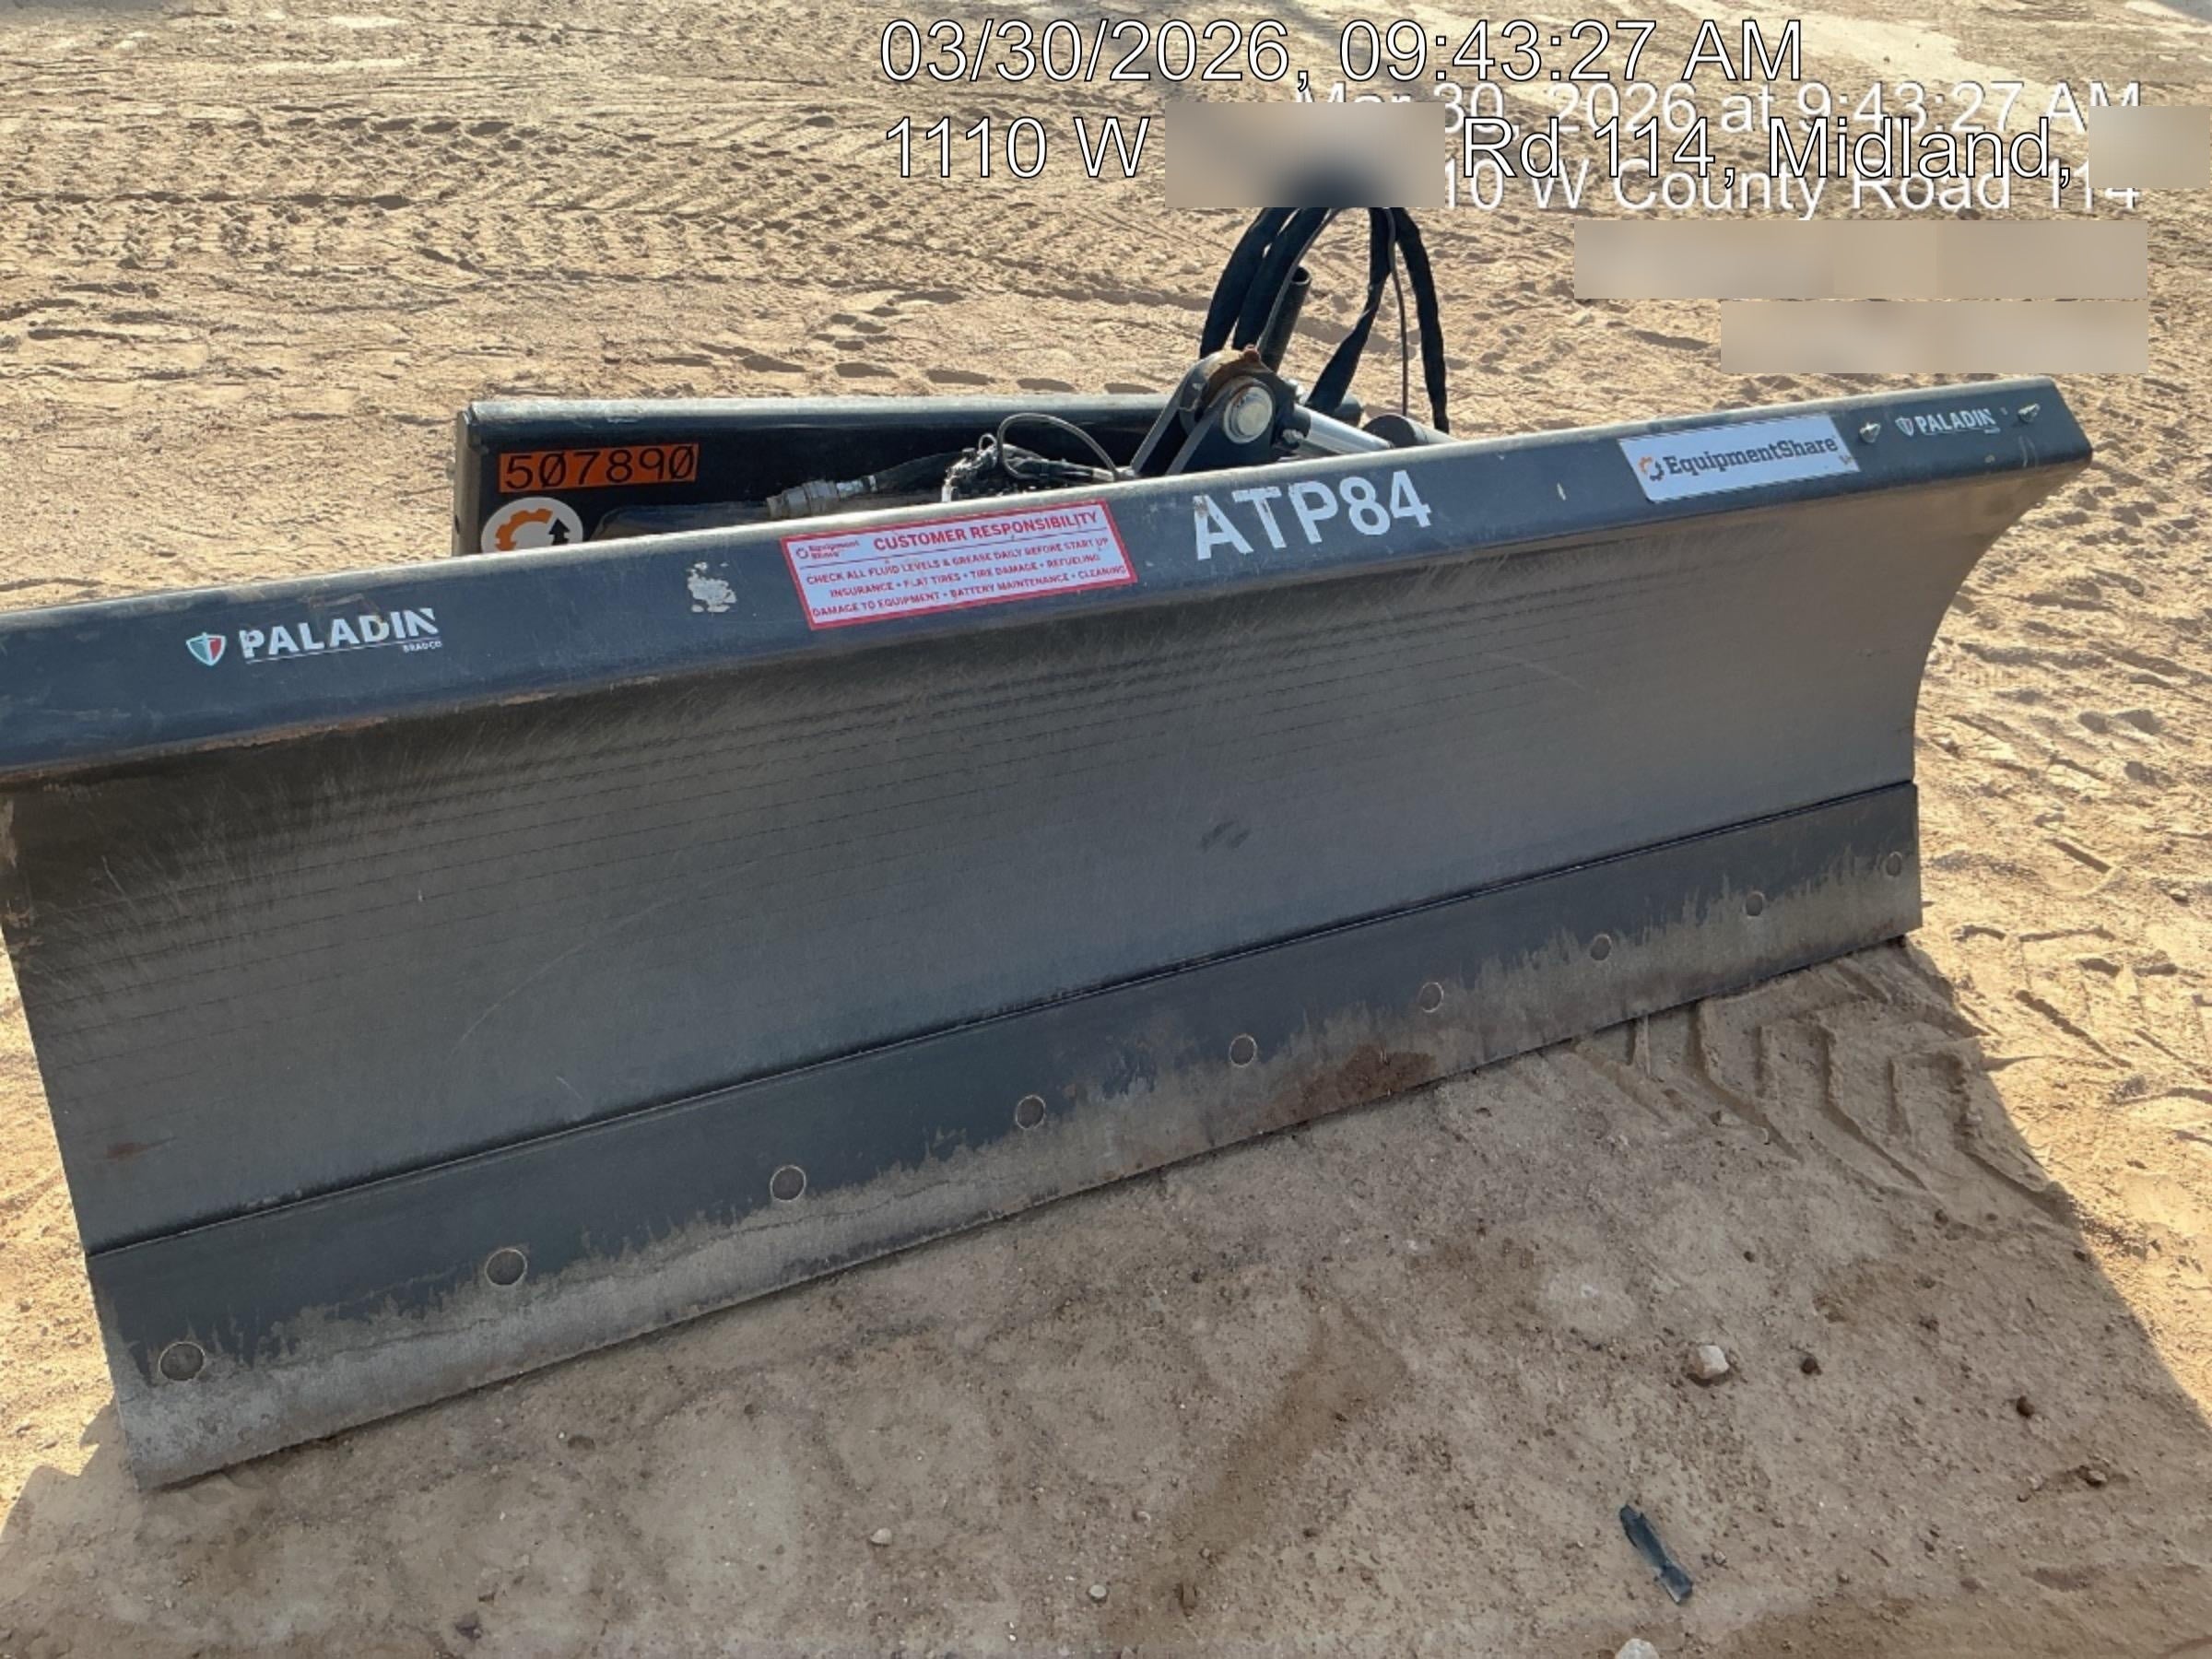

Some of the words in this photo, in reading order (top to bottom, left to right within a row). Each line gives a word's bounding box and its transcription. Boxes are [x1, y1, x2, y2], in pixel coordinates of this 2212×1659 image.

[1914, 408, 1997, 433] PALADIN
[505, 444, 697, 489] 507890
[1663, 435, 1840, 477] EquipmentShare
[874, 528, 967, 551] CUSTOMER
[970, 512, 1098, 539] RESPONSIBILITY
[1193, 470, 1431, 560] ATP84
[806, 571, 845, 585] CHECK
[847, 569, 866, 580] ALL
[869, 565, 900, 578] FLUID
[902, 559, 940, 572] LEVELS
[952, 553, 992, 566] GREASE
[994, 548, 1023, 560] DAILY
[1024, 543, 1063, 557] BEFORE
[1065, 539, 1094, 551] START
[1096, 537, 1109, 547] UP
[830, 582, 895, 598] INSURANCE
[903, 578, 929, 589] FLAT
[931, 572, 960, 584] TIRES
[970, 567, 993, 579] TIRE
[994, 562, 1039, 575] DAMAGE
[1046, 553, 1101, 569] REFUELING
[812, 603, 858, 617] DAMAGE
[861, 600, 876, 610] TO
[877, 592, 939, 607] EQUIPMENT
[949, 582, 995, 598] BATTERY
[996, 574, 1070, 590] MAINTENANCE
[1077, 565, 1127, 580] CLEANING
[239, 608, 440, 659] PALADIN
